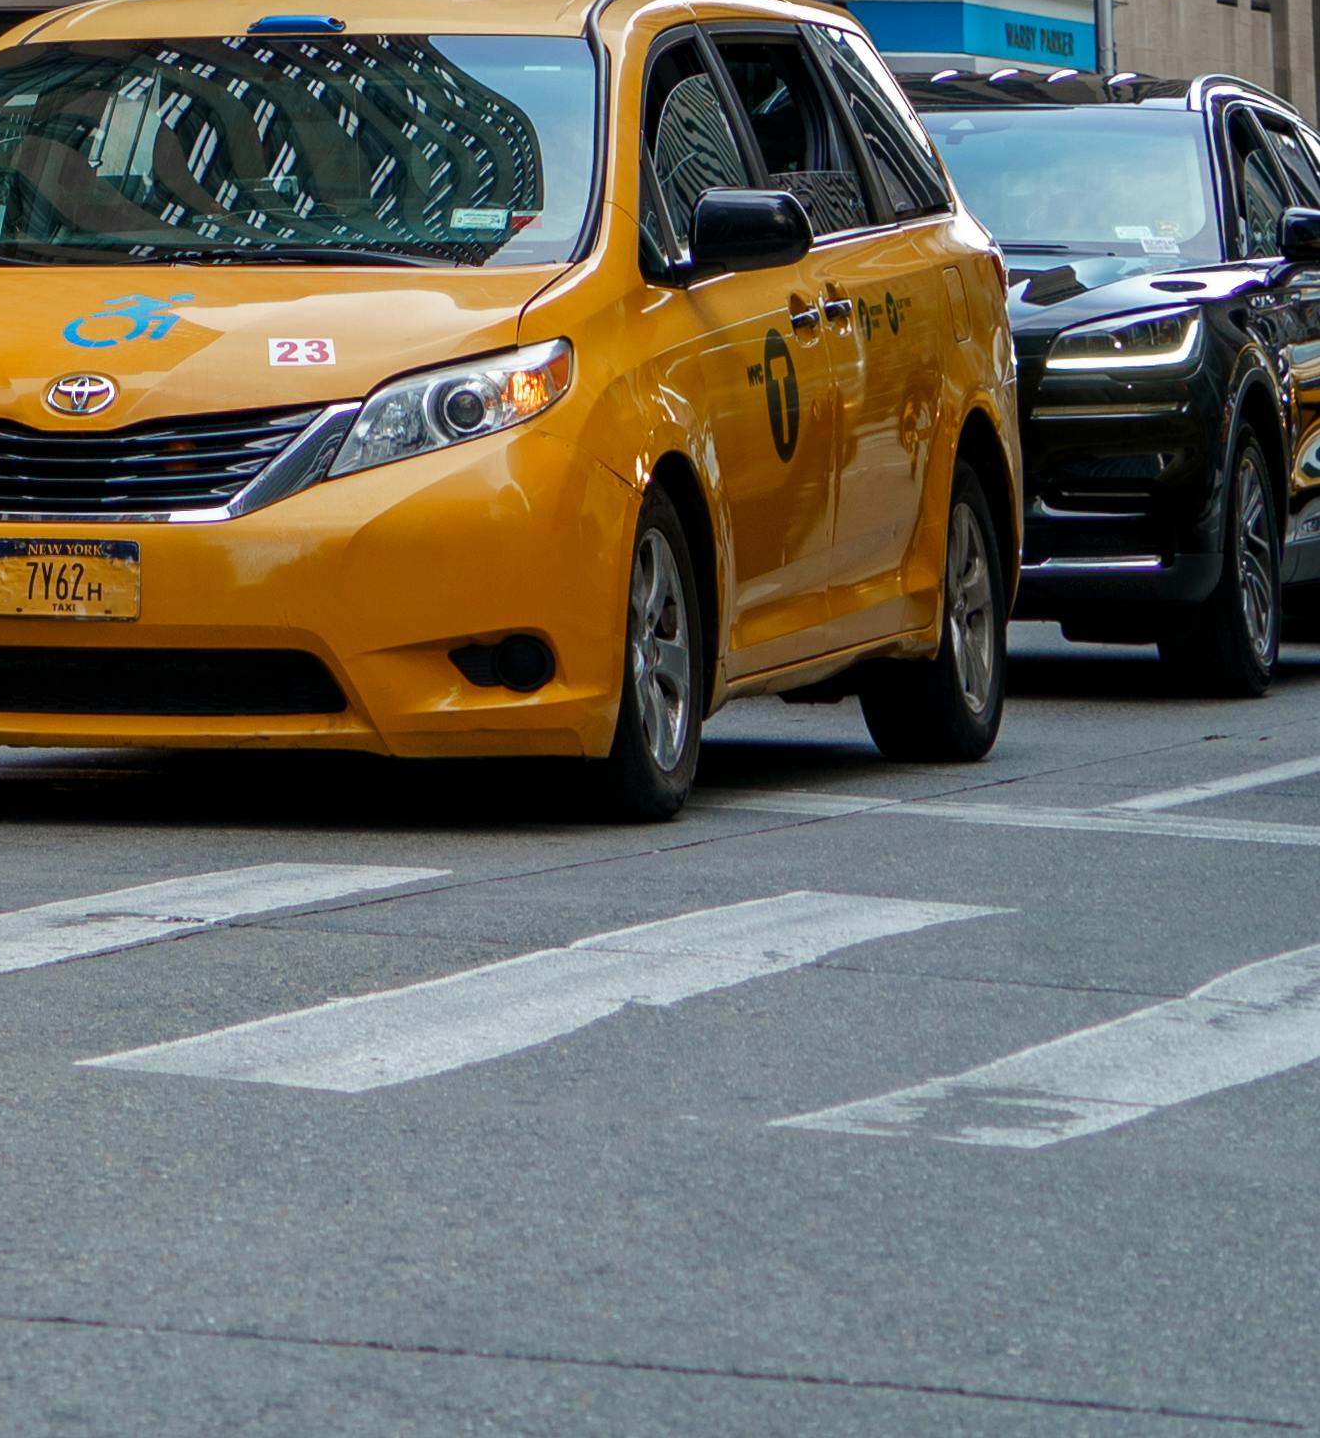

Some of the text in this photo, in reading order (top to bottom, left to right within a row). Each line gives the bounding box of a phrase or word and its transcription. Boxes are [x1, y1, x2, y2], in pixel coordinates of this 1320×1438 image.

[276, 340, 330, 363] 23
[27, 543, 102, 557] NEW YORK
[52, 603, 76, 612] TAXI
